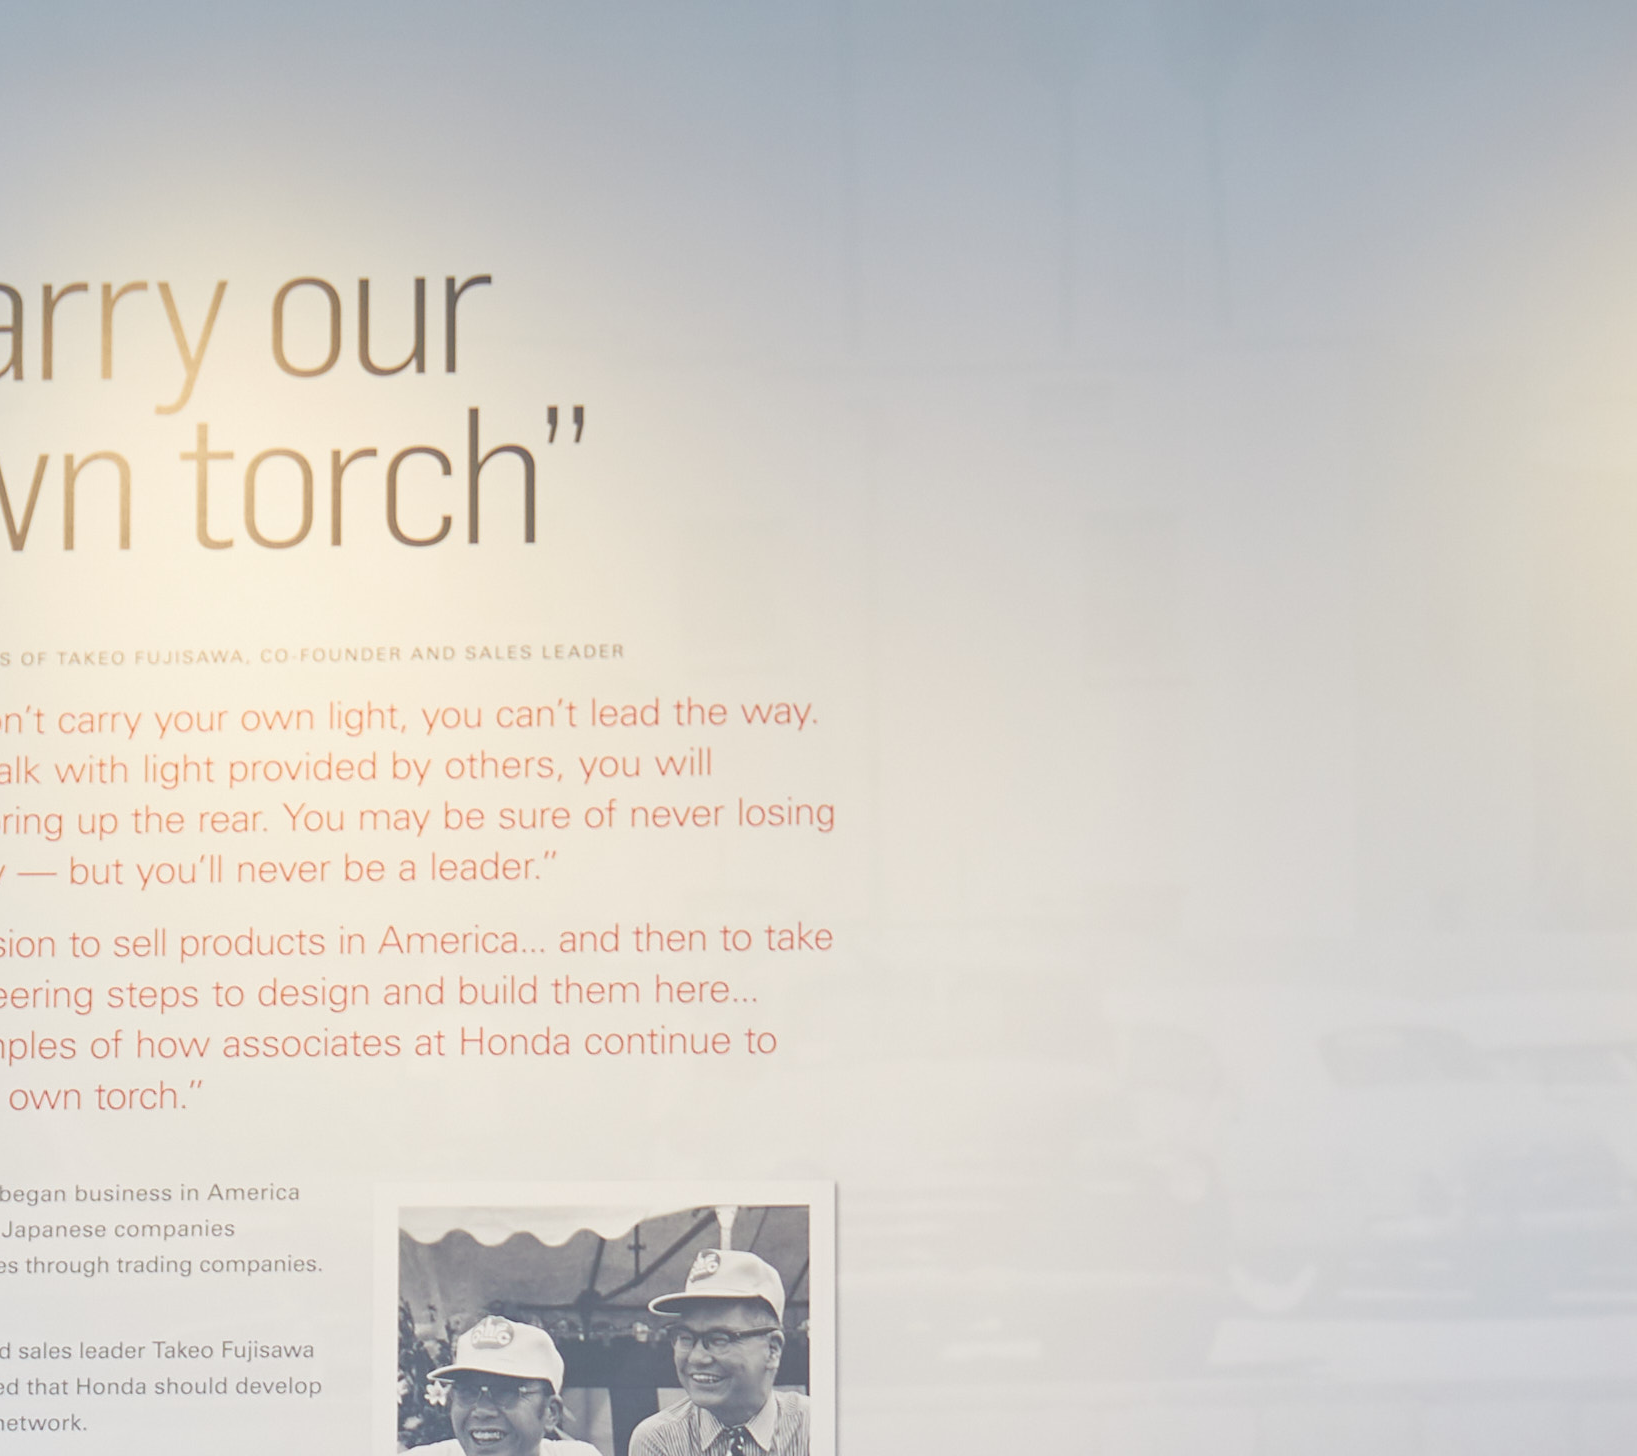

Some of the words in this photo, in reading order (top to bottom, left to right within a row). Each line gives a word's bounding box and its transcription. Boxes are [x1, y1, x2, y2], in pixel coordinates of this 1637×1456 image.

[272, 274, 492, 378] our
[20, 651, 46, 666] OF
[58, 651, 125, 666] TAKEO
[135, 650, 250, 666] FUJISAWA,
[260, 646, 401, 663] CO-FOUNDER
[411, 646, 455, 661] AND
[465, 645, 533, 660] SALES
[542, 643, 625, 659] LEADER
[58, 712, 141, 739] carry
[155, 711, 227, 738] your
[241, 710, 314, 731] own
[330, 701, 406, 736] light,
[422, 708, 481, 735] you
[592, 698, 659, 726] lead
[675, 697, 727, 725] the
[742, 703, 816, 730] way.
[55, 756, 127, 783] with
[145, 755, 213, 789] light
[230, 752, 376, 788] provided
[393, 752, 431, 785] by
[446, 751, 562, 781] others,
[579, 756, 640, 784] you
[656, 747, 711, 776] will
[0, 1185, 66, 1206] began
[75, 1185, 172, 1202] business
[181, 1184, 199, 1200] in
[208, 1184, 299, 1201] America
[2, 1221, 106, 1241] Japanese
[114, 1220, 235, 1241] companies
[19, 1342, 72, 1359] sales
[80, 1342, 145, 1359] leader
[153, 1341, 213, 1359] Takeo
[222, 1341, 314, 1362] Fujisawa
